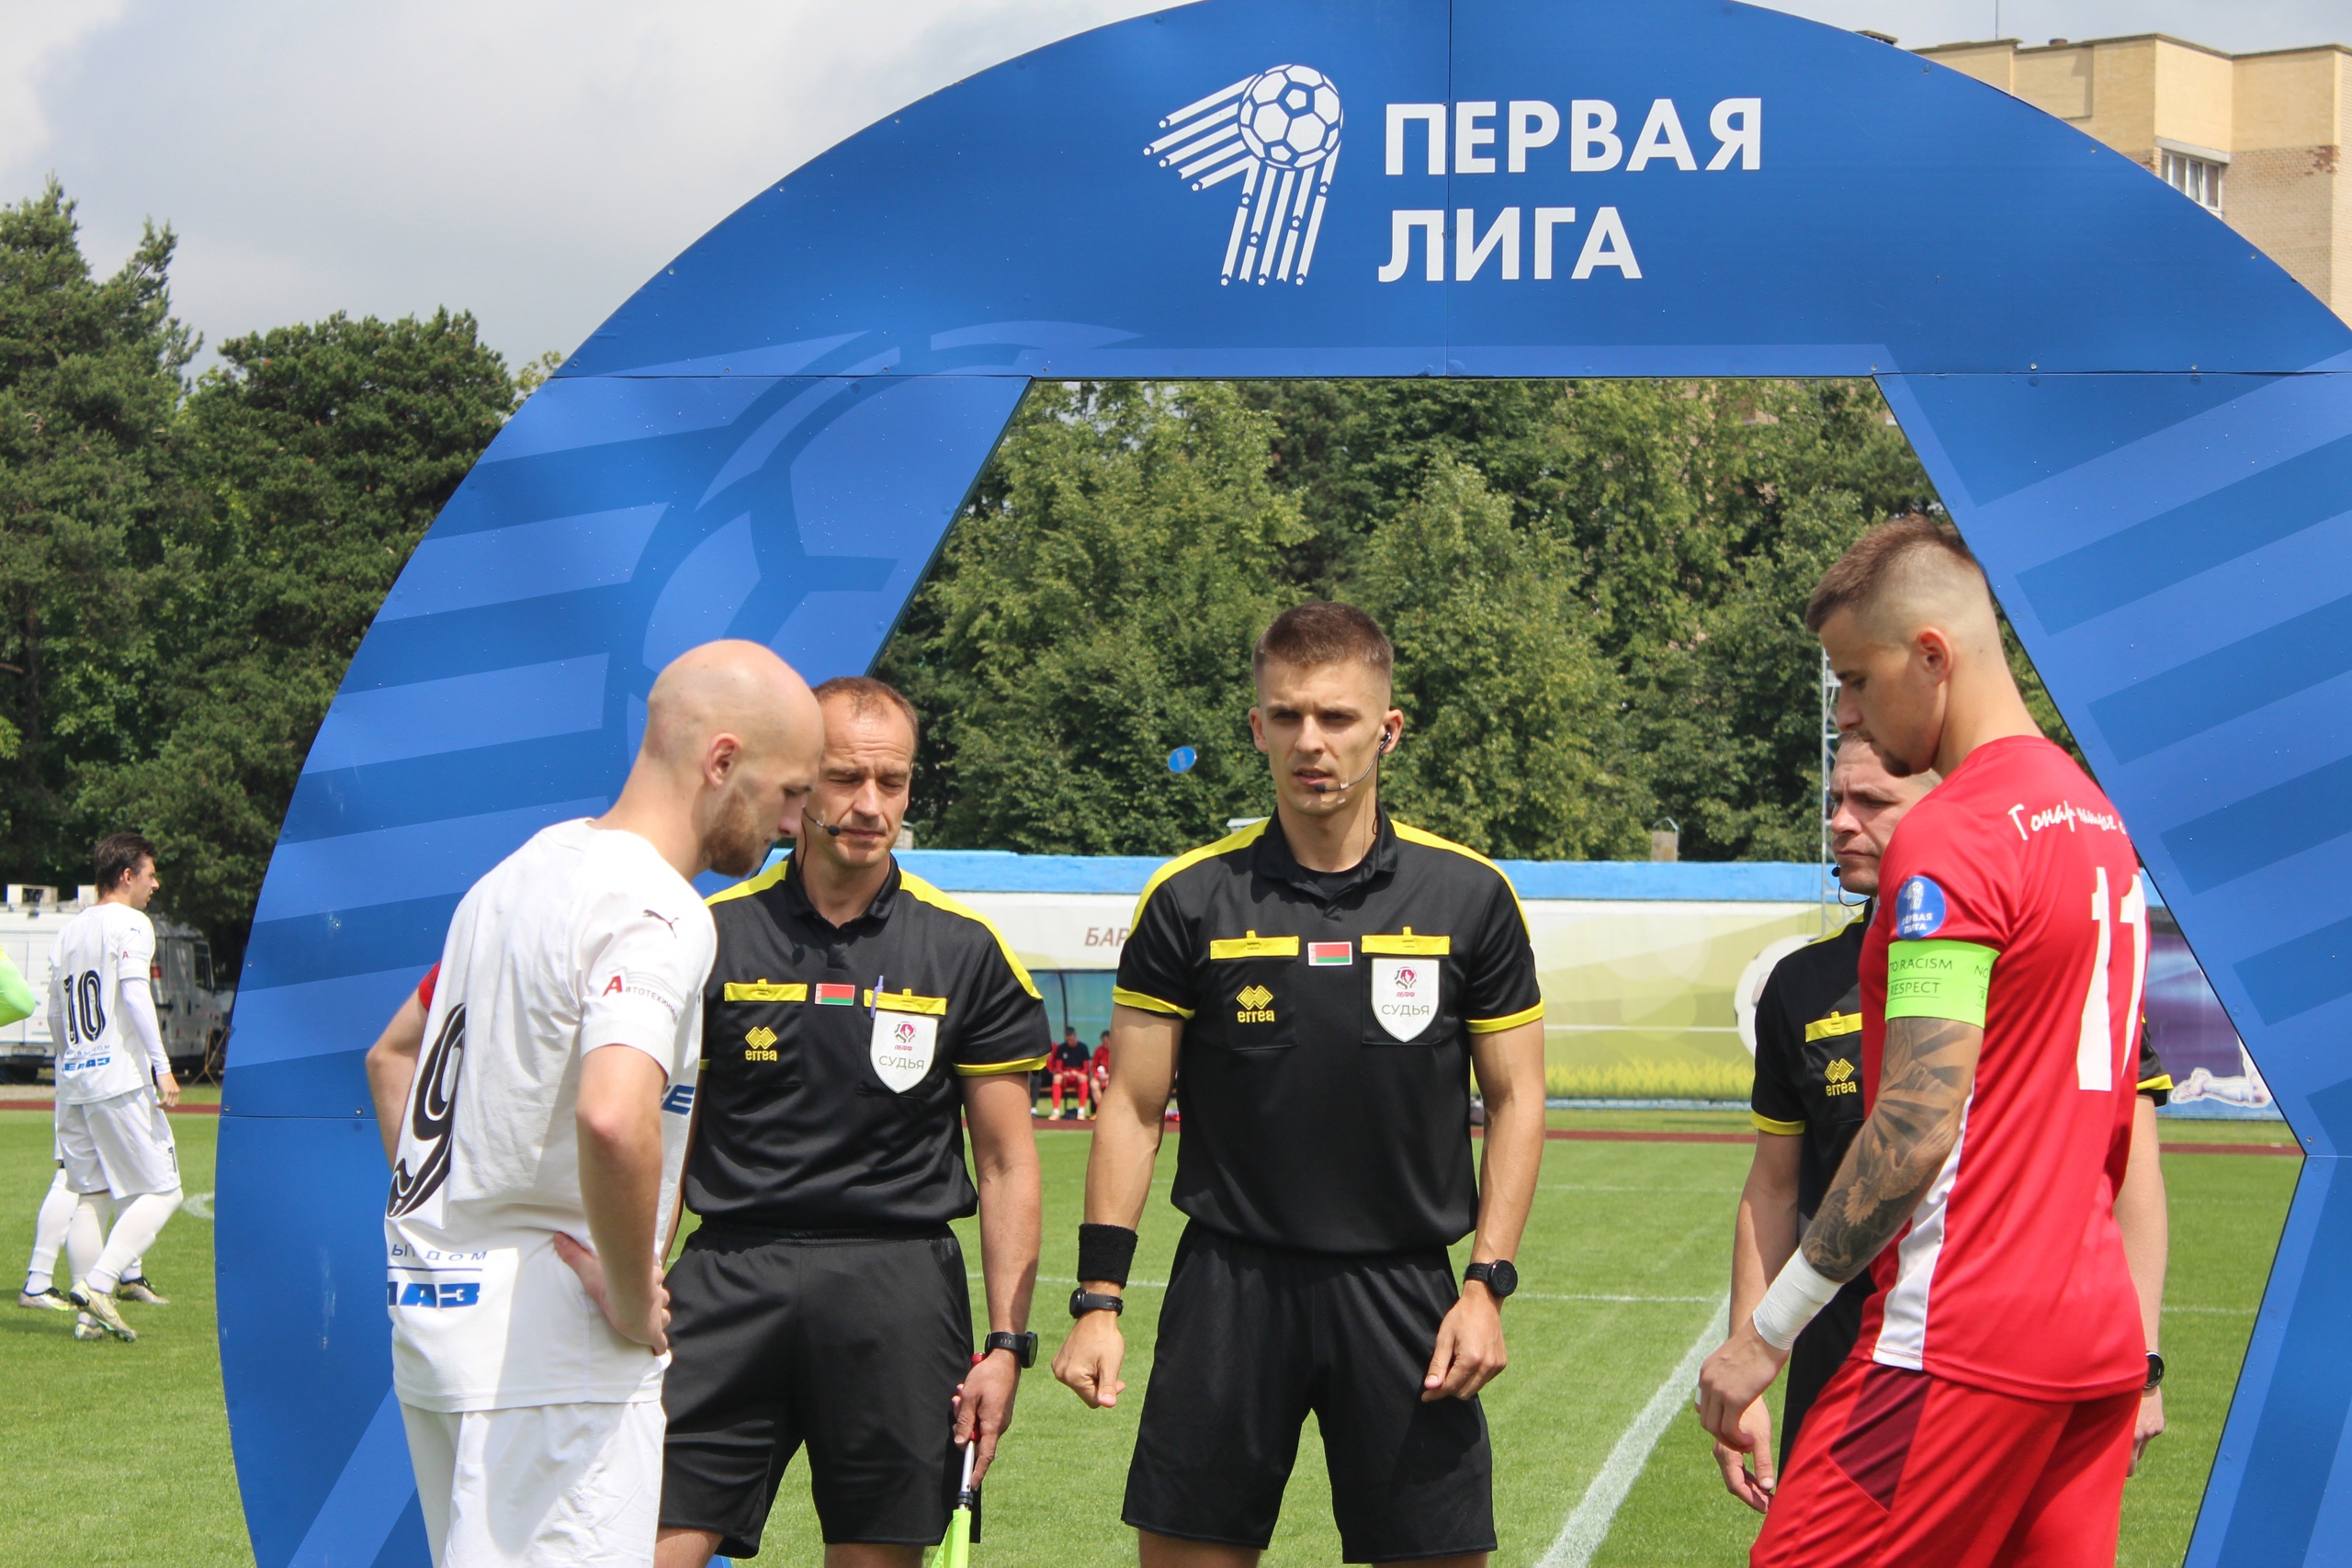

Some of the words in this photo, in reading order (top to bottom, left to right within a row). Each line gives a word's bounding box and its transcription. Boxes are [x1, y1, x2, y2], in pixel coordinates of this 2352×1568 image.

[1385, 97, 1761, 175] ПЕРВАЯ
[1378, 207, 1643, 283] ЛИГА
[1900, 958, 1953, 971] RACISM
[1890, 981, 1940, 997] RESPECT
[63, 969, 106, 1044] 10
[1381, 1004, 1430, 1017] СУДЬЯ
[1237, 1010, 1275, 1023] errea
[745, 1049, 777, 1061] errea
[878, 1055, 925, 1070] СУДЬЯ
[1826, 1081, 1857, 1097] errea
[424, 1250, 488, 1261] ДОМ
